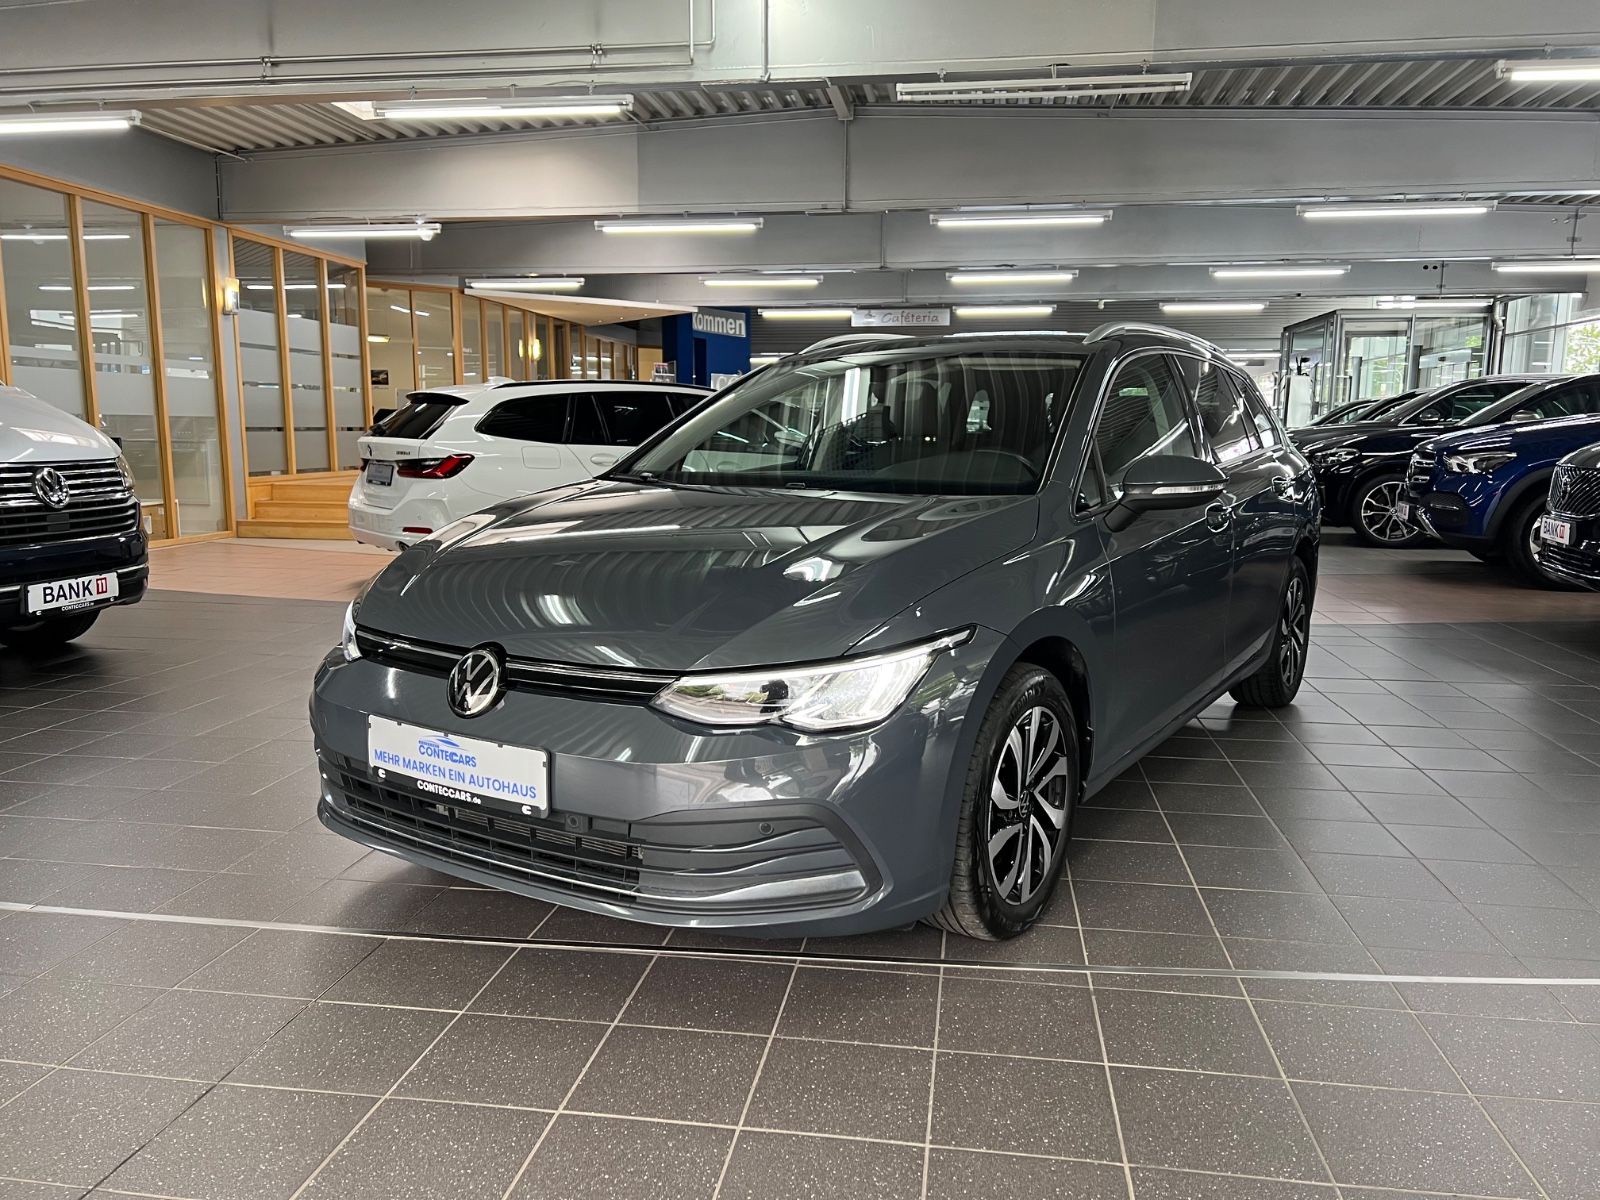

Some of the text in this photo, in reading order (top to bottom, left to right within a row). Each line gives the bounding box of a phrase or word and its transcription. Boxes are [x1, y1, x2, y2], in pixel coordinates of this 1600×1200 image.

[42, 577, 108, 604] BANK 11
[374, 749, 537, 799] MEHR MARKEN EIN AUTOHAUS
